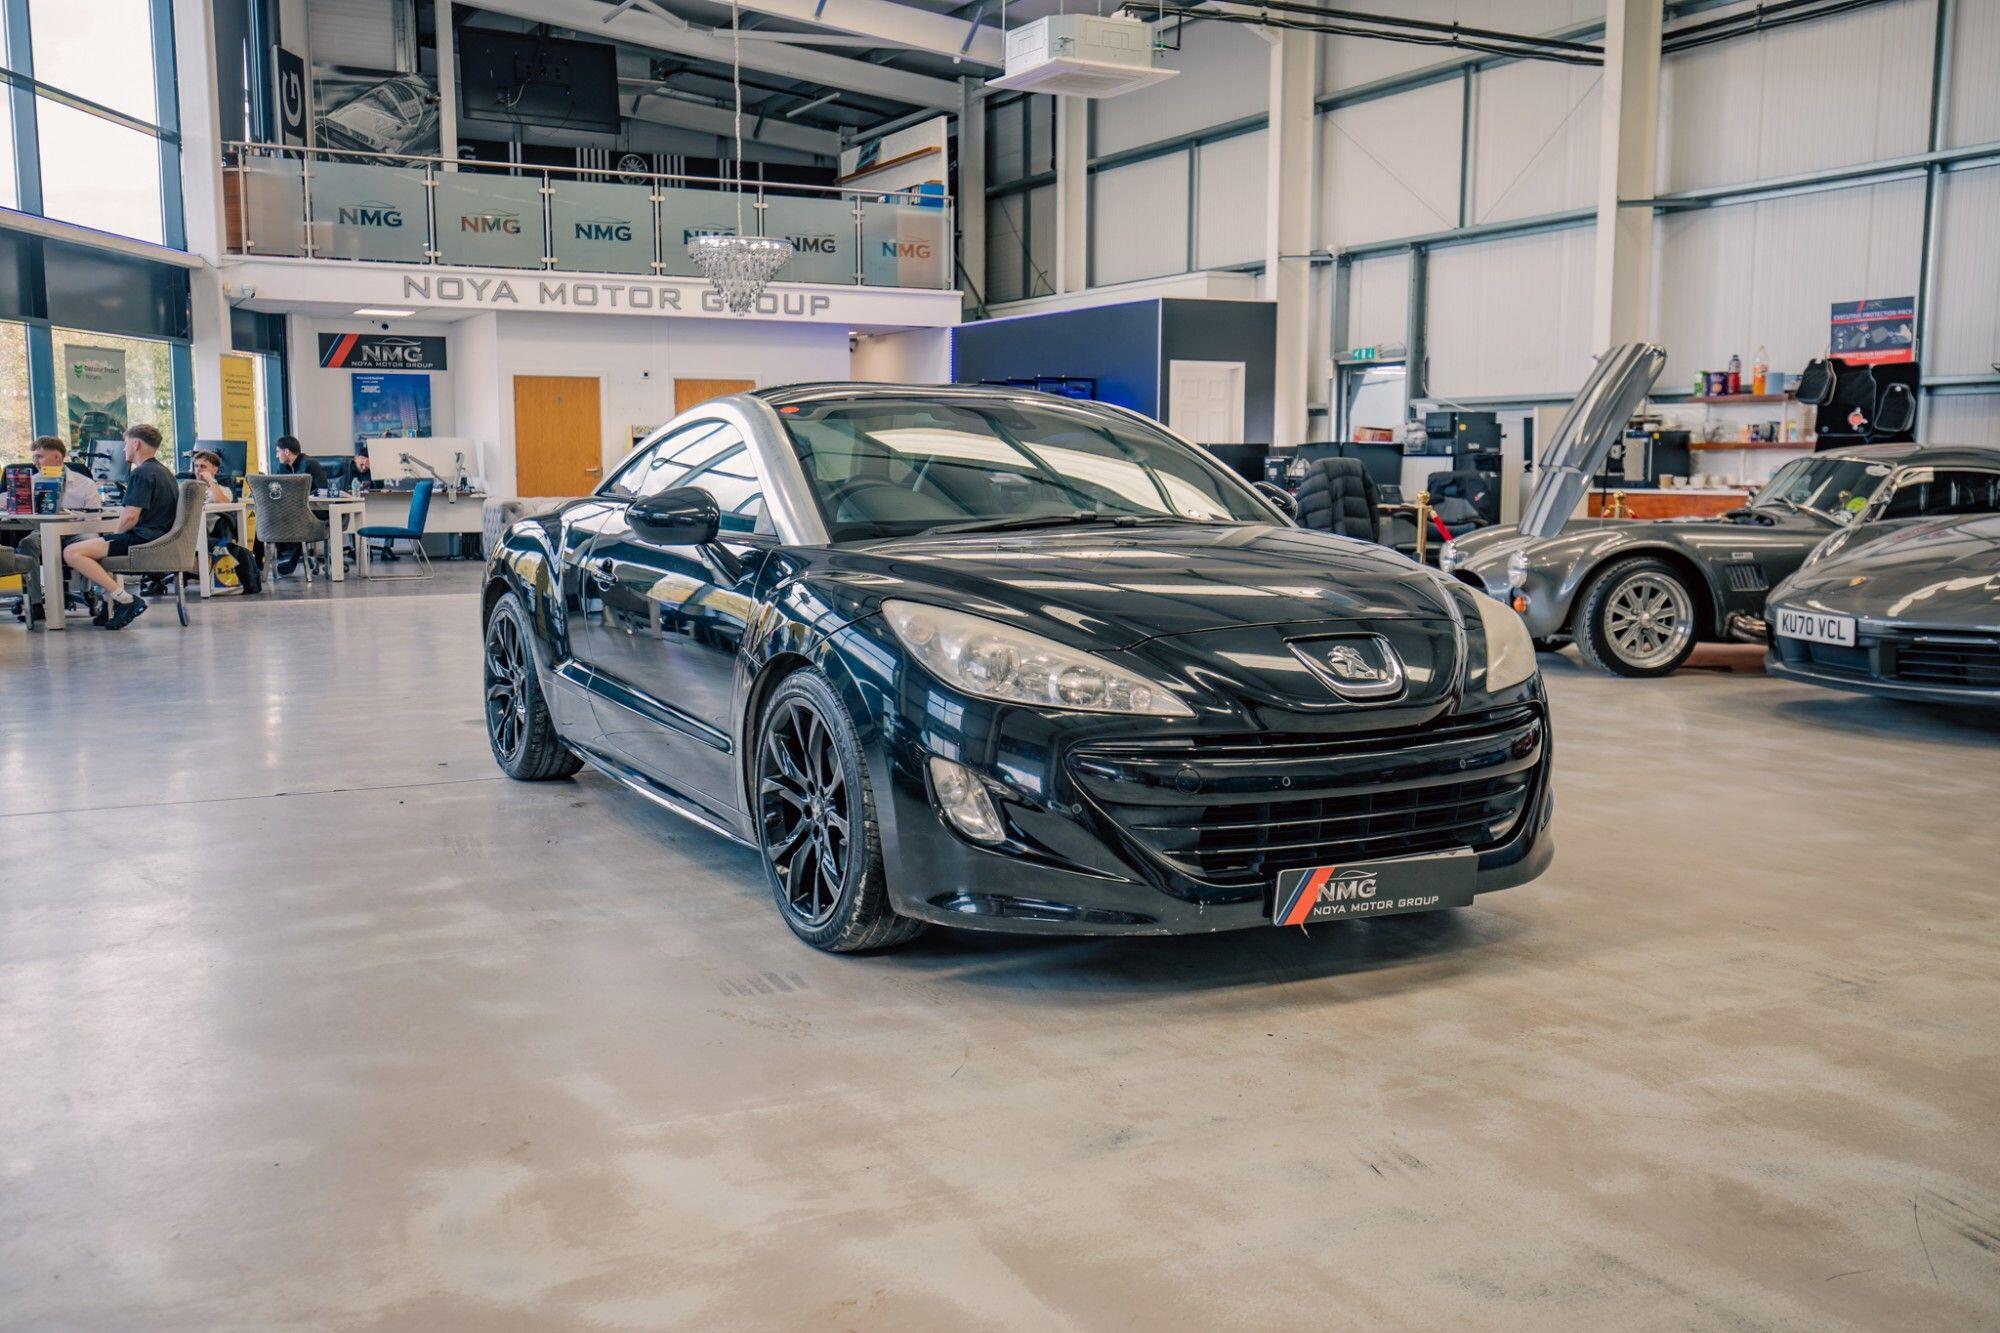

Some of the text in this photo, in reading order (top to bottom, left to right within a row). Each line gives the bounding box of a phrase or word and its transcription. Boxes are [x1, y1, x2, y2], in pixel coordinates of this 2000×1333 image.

[338, 207, 402, 227] NMG
[460, 215, 521, 234] NMG
[574, 222, 632, 242] NMG
[785, 236, 836, 253] NMG
[882, 242, 931, 259] NMG
[403, 275, 830, 316] NOYA MOTOR GOUP
[361, 345, 423, 362] NMG
[1782, 612, 1847, 640] KU70 VCL
[1316, 878, 1377, 902] NMG
[1313, 895, 1439, 916] NOYA MOTOR GROUP
